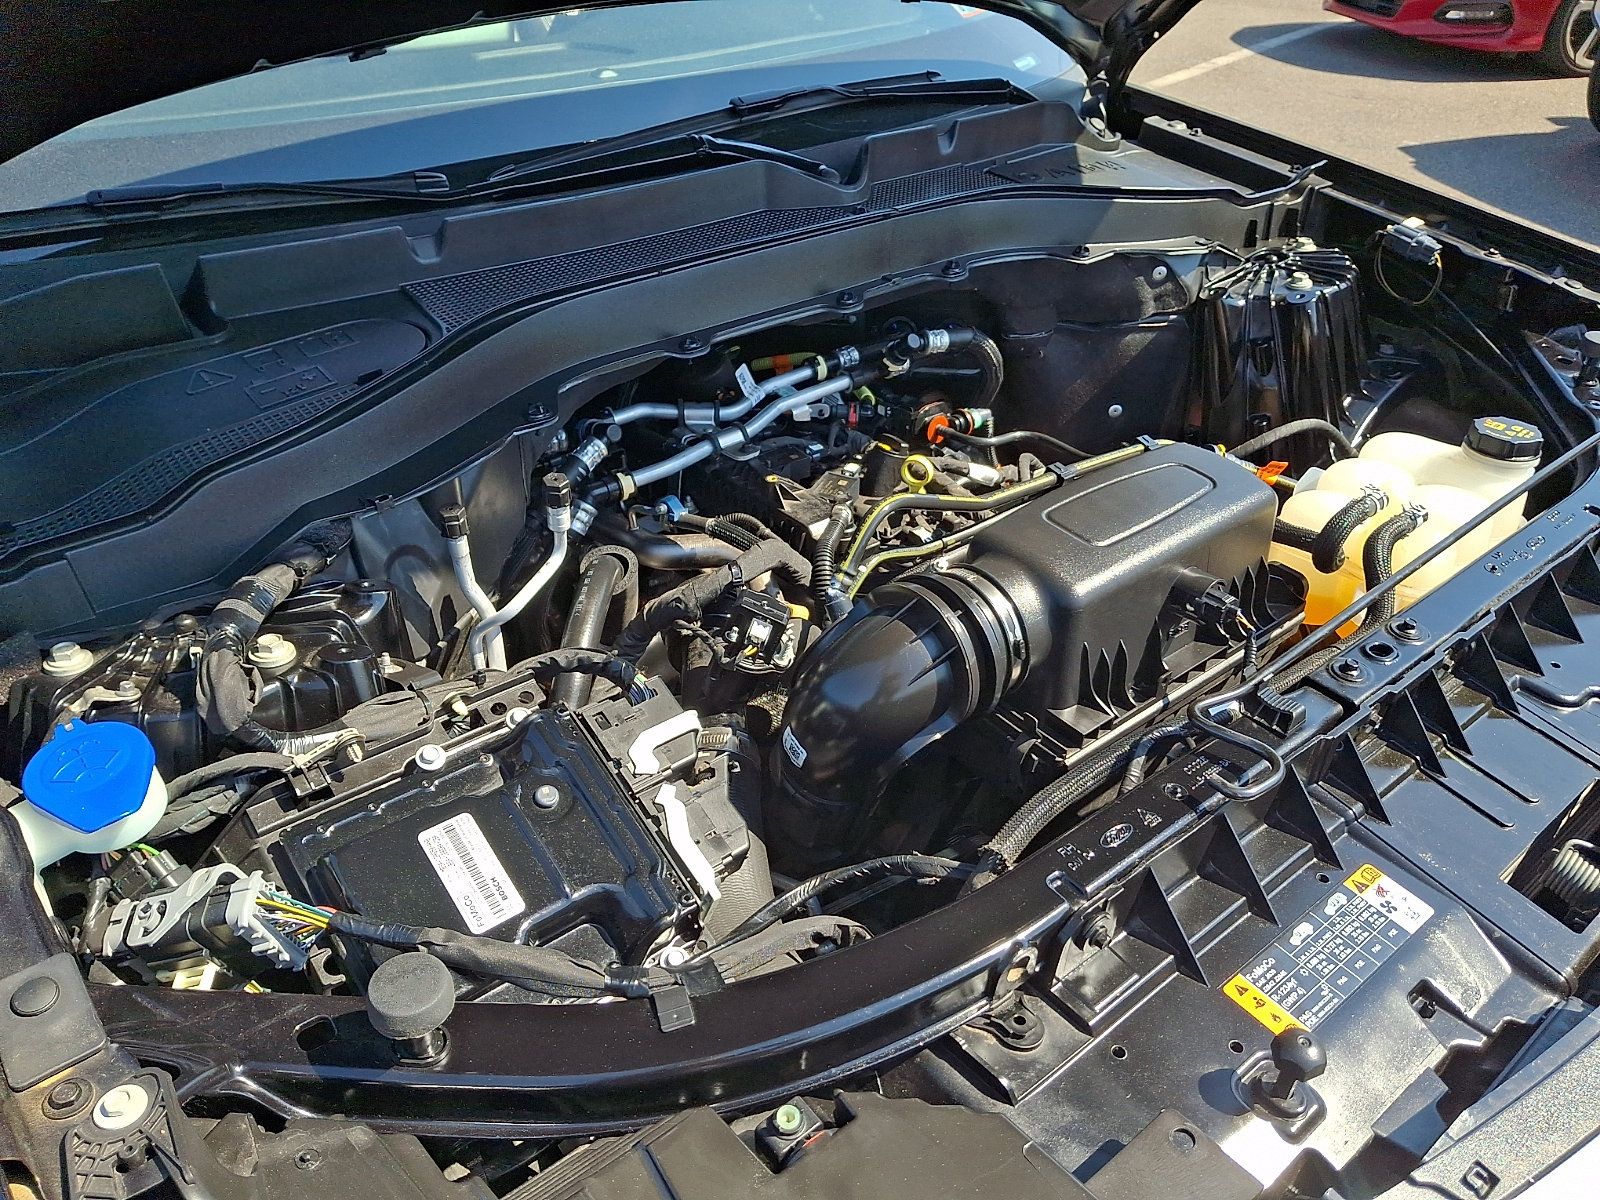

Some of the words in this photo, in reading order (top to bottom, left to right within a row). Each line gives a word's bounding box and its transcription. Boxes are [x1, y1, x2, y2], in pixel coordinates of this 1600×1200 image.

[491, 877, 508, 900] BOSCH
[464, 896, 484, 927] FoMoCo
[1246, 958, 1275, 981] FoMoCo
[1272, 978, 1297, 1001] R-1234yf
[1281, 992, 1298, 1009] (GWP
[1299, 1011, 1312, 1022] PAG
